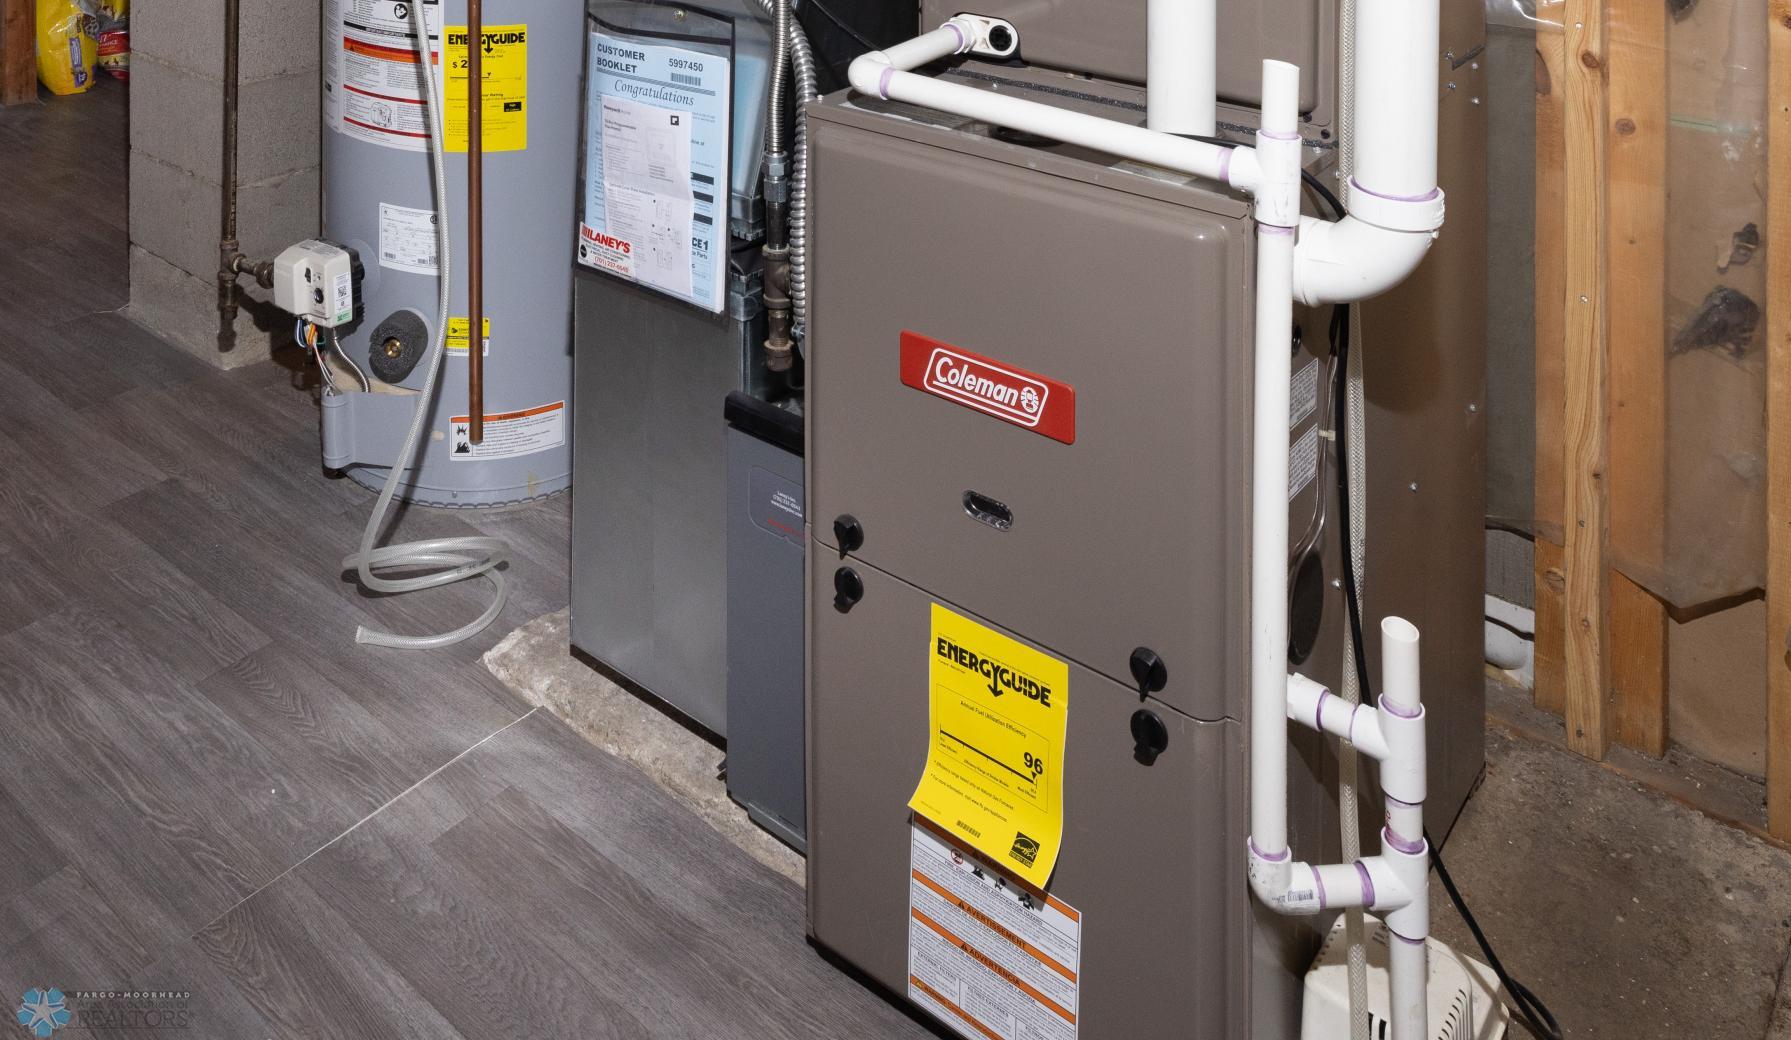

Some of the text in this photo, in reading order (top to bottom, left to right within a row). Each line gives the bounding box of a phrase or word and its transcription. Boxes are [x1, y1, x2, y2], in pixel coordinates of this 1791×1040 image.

[448, 32, 526, 47] ENEGYGUIDE
[597, 43, 704, 73] CUSTOMER 5997450
[597, 57, 637, 74] BOOKLET
[614, 79, 695, 106] Congratulations
[590, 228, 631, 254] LANEY'S
[935, 356, 1019, 407] Coleman
[937, 637, 1052, 708] ENERGYGUIDE
[975, 707, 985, 717] Fuel
[985, 712, 1006, 728] Utilization
[1006, 723, 1027, 739] Efficiency
[1023, 751, 1044, 775] 96
[967, 904, 1026, 949] AVERTISSEMENT
[969, 949, 1021, 986] ADVERTENCIA
